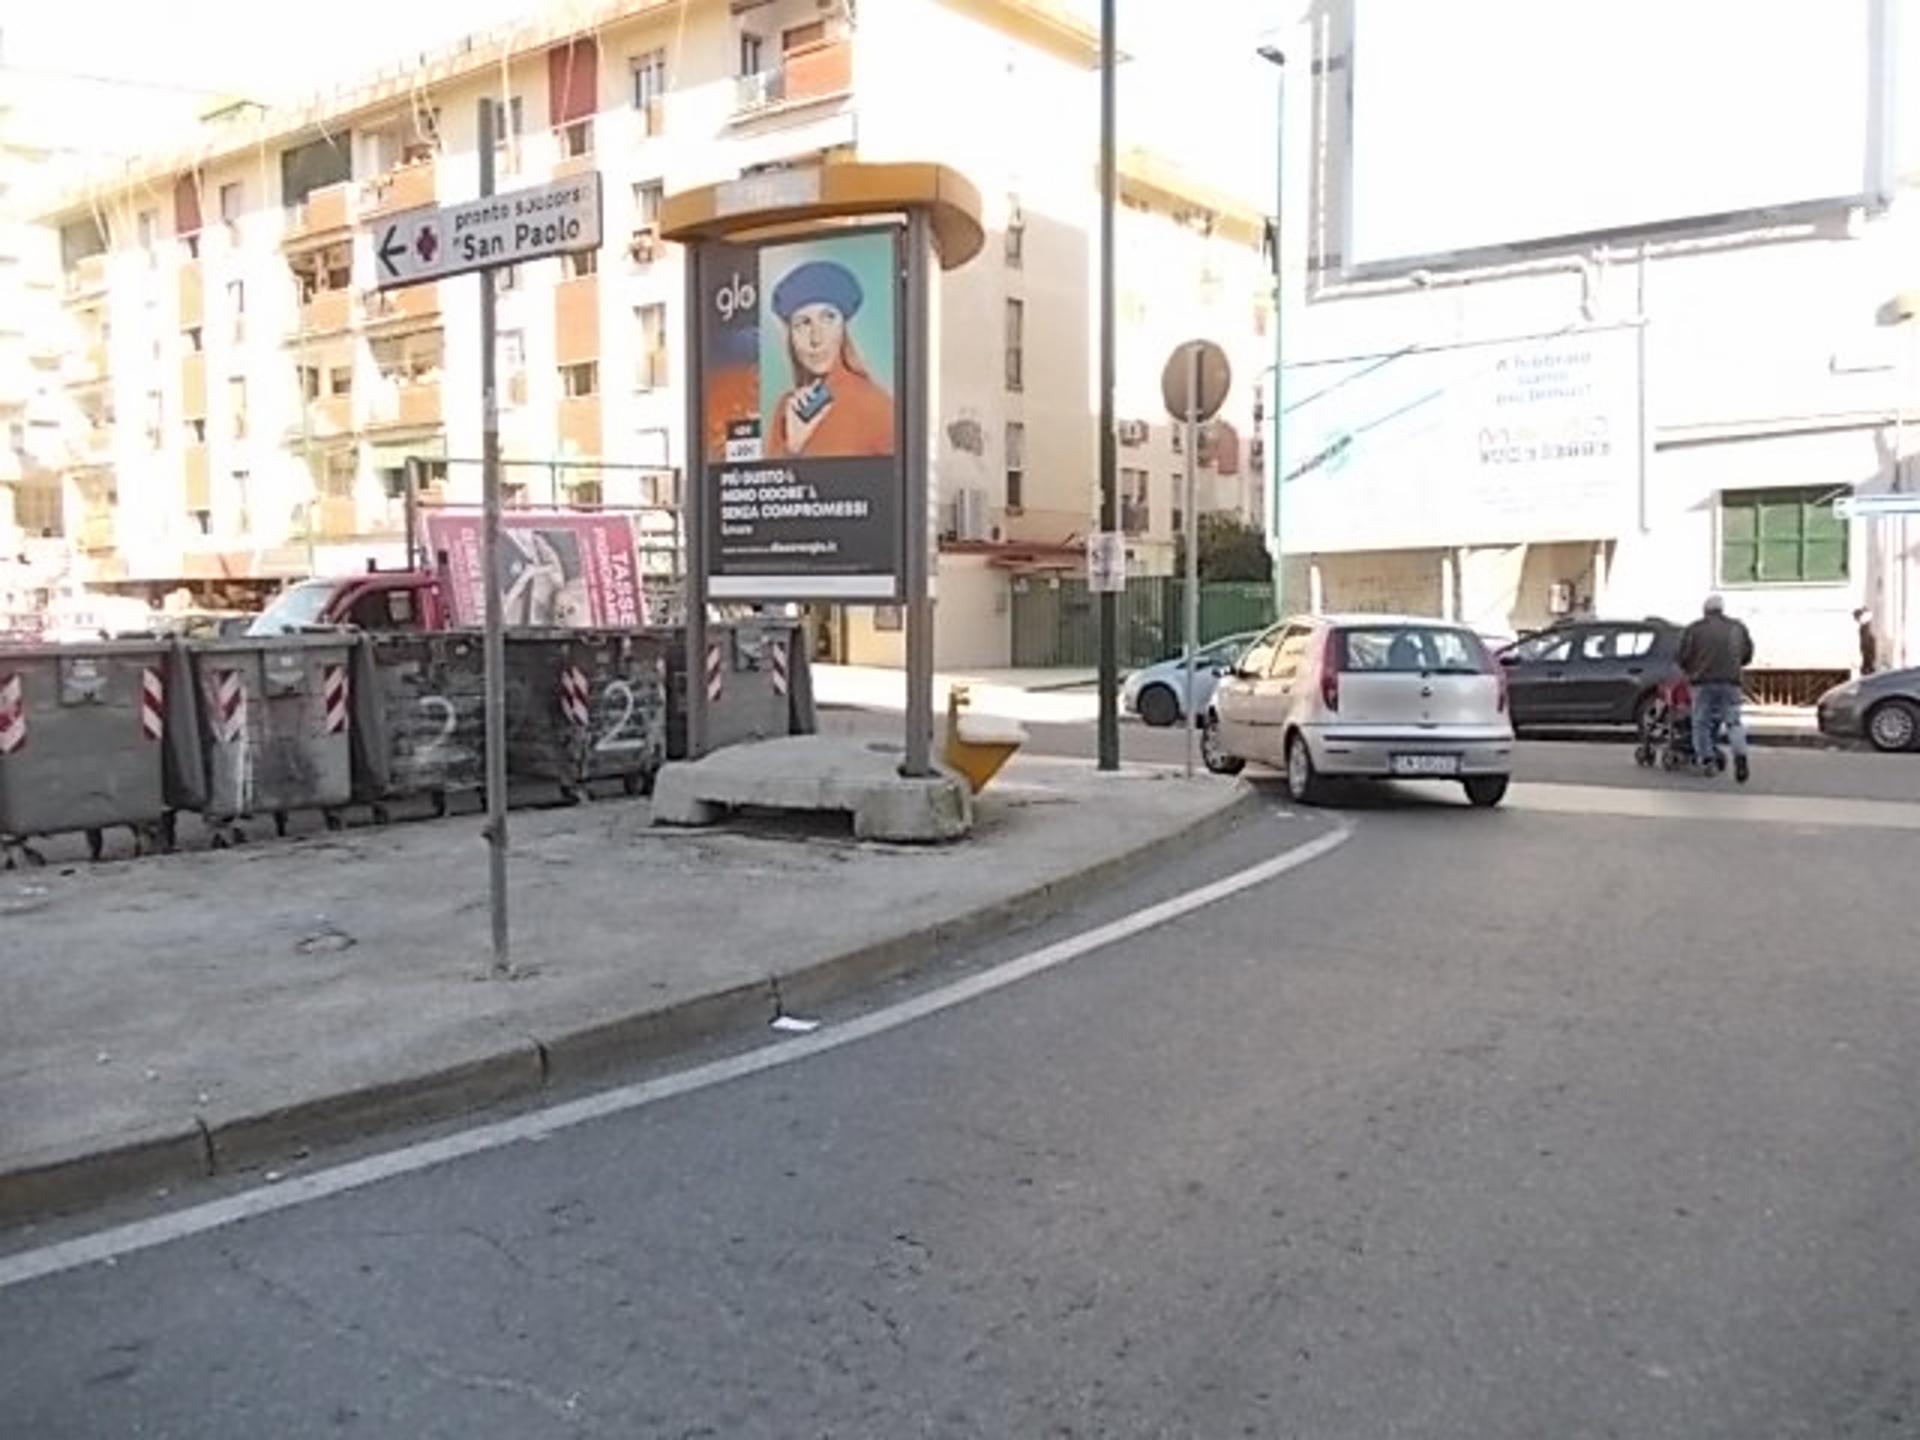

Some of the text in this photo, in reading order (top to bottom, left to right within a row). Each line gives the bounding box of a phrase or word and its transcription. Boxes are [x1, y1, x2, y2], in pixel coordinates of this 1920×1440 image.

[455, 203, 510, 233] pronto
[716, 272, 756, 320] glo
[761, 500, 868, 519] COMPROMESSI
[594, 681, 646, 750] 2
